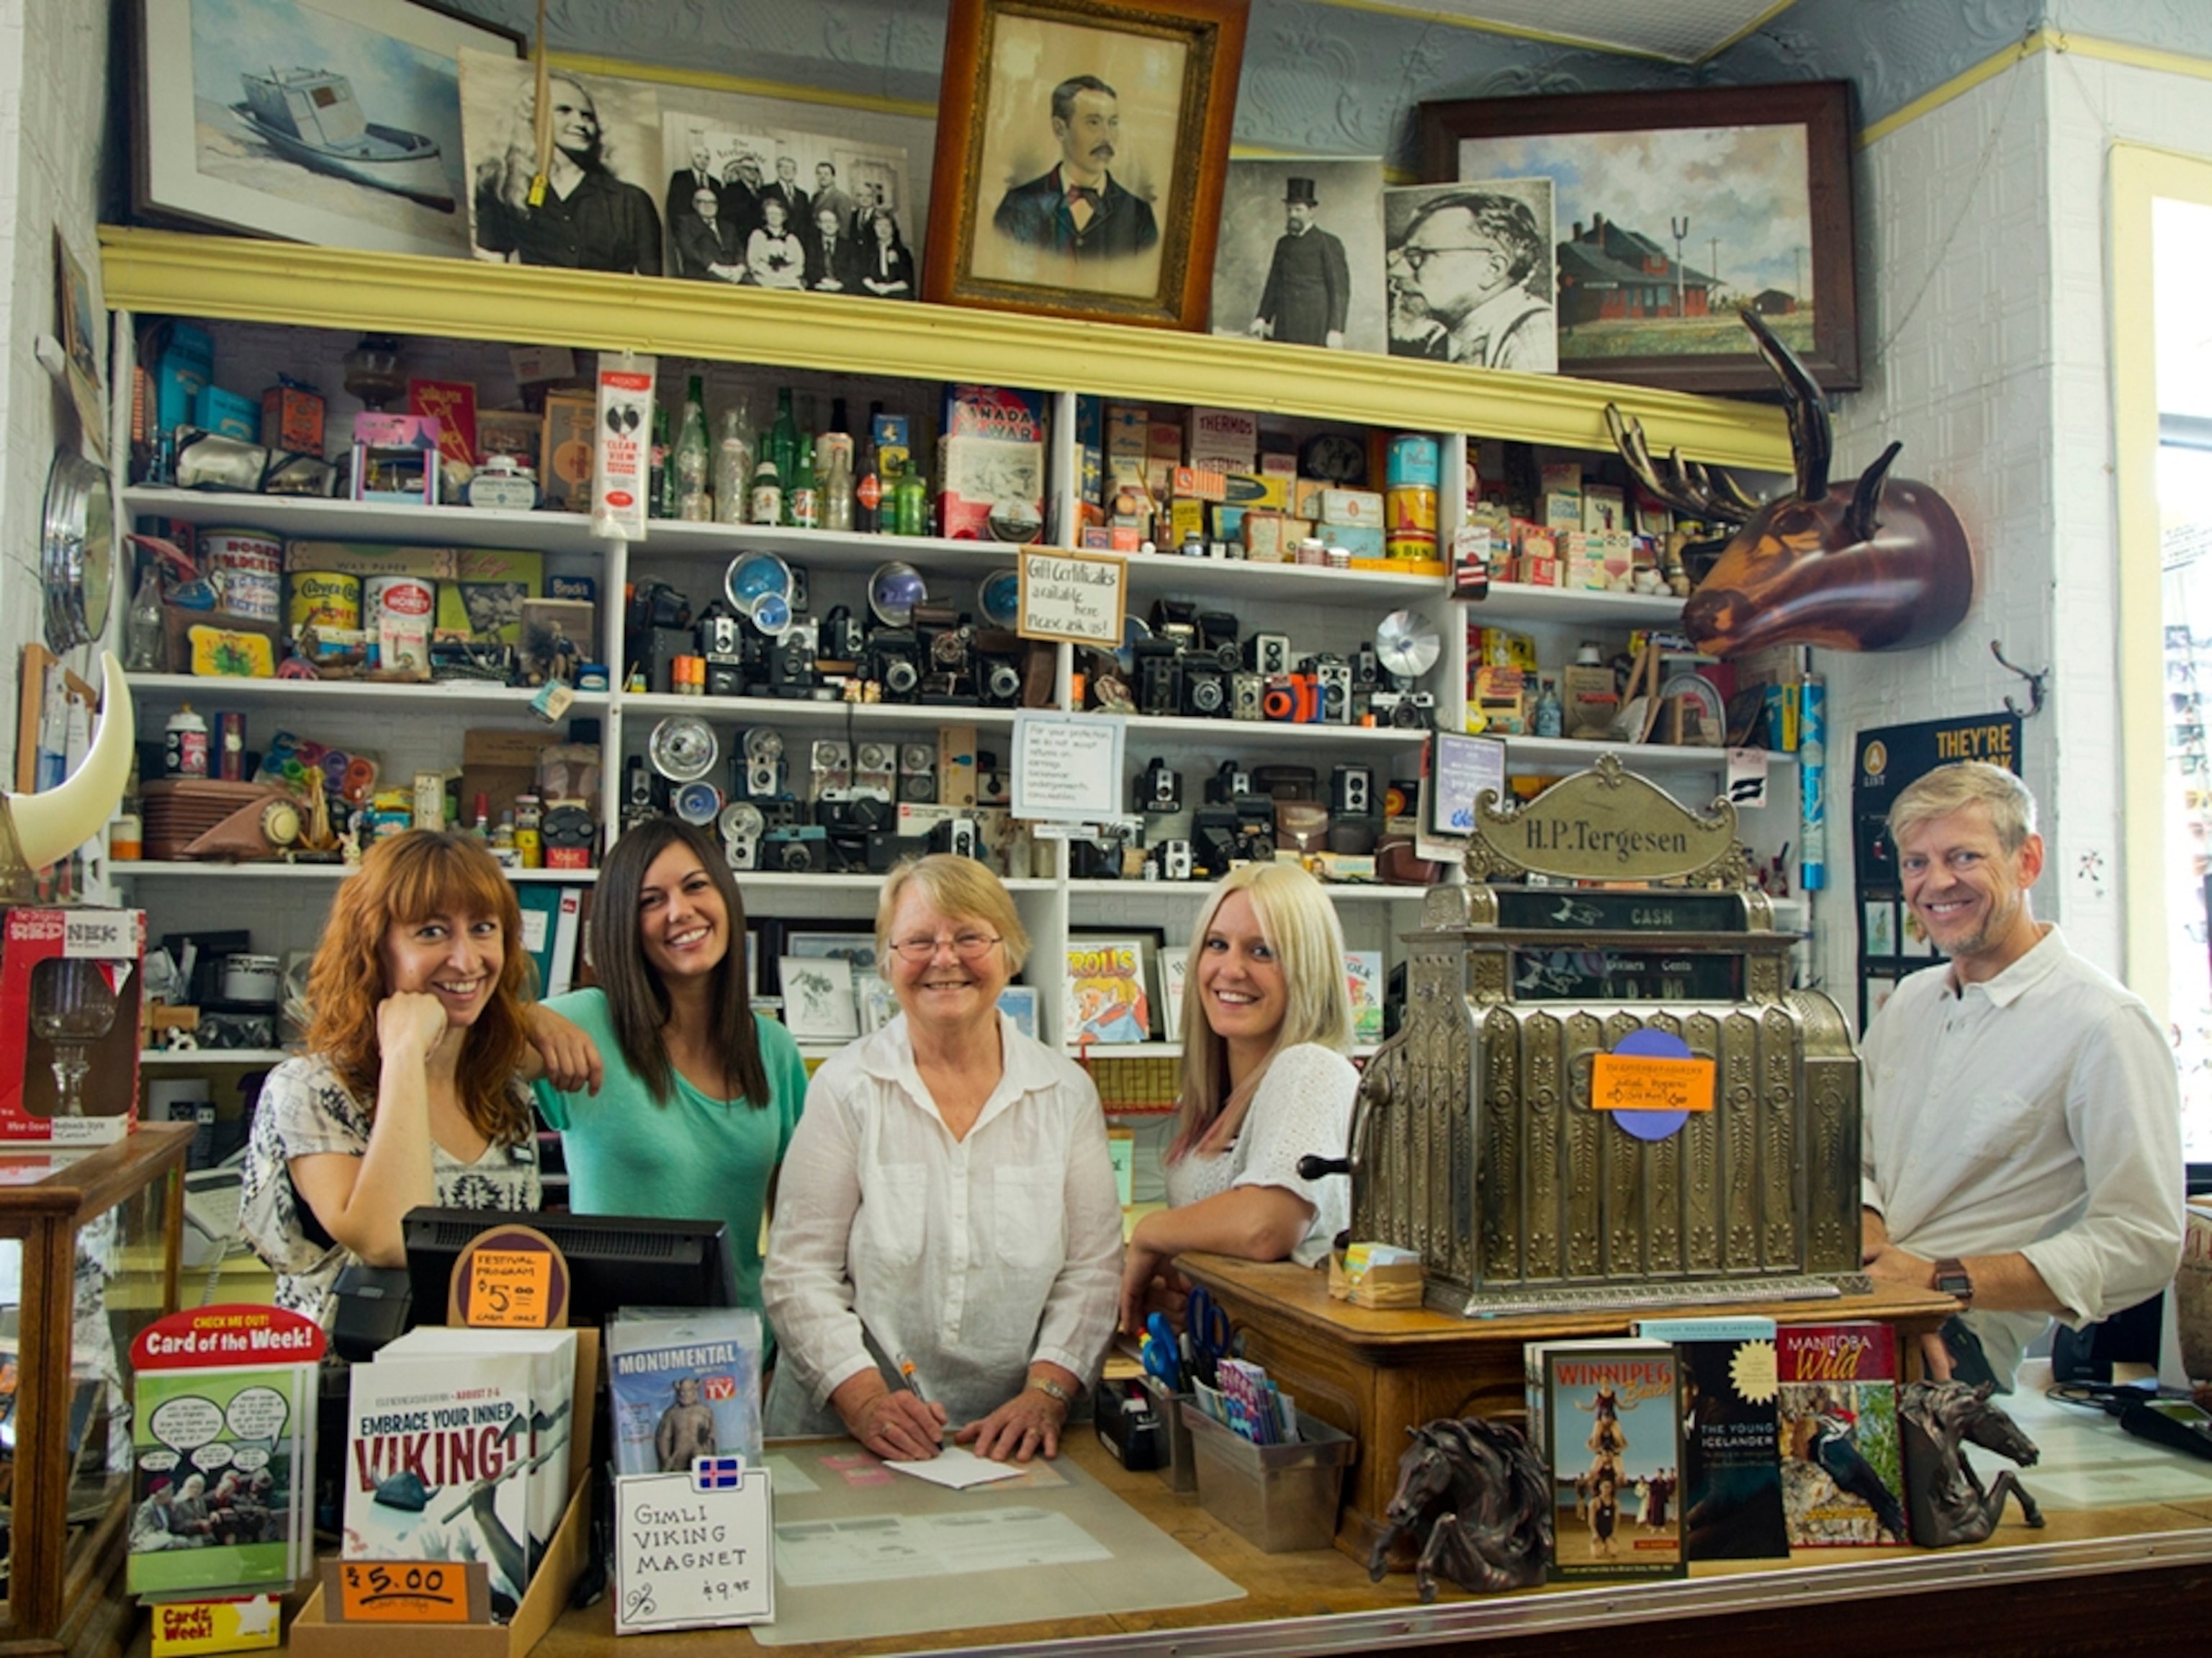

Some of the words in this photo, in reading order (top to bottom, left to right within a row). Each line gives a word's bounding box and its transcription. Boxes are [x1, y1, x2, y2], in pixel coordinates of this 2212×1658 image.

[1200, 415, 1252, 436] THERMOS
[1937, 724, 2013, 759] THEY'RE
[1631, 908, 1673, 925] CASH
[11, 922, 63, 941] RED
[1661, 960, 1693, 972] Cents
[477, 1255, 536, 1265] FESTIVAL
[476, 1267, 535, 1277] PROGRAM
[193, 1317, 226, 1329] CHECK
[227, 1315, 243, 1327] ME
[245, 1314, 269, 1327] OUT!
[146, 1330, 197, 1355] Card
[198, 1332, 219, 1353] of
[220, 1332, 248, 1351] the
[250, 1326, 313, 1350] Week!
[1787, 1335, 1872, 1352] MANITOBA
[619, 1344, 736, 1375] MONUMENTAL
[1797, 1341, 1864, 1380] Wild
[1555, 1361, 1673, 1386] WINNIPEG
[706, 1381, 734, 1400] TV
[361, 1412, 429, 1436] EMBRACE
[433, 1407, 469, 1429] YOUR
[474, 1401, 514, 1424] INNER
[1701, 1424, 1725, 1434] THE
[1729, 1422, 1775, 1434] YOUNG
[1701, 1435, 1773, 1448] ICELANDER
[634, 1504, 707, 1525] GIMLI
[632, 1525, 726, 1549] VIKING
[636, 1549, 747, 1574] MAGNET
[163, 1606, 199, 1625] Card
[164, 1621, 213, 1641] Week!
